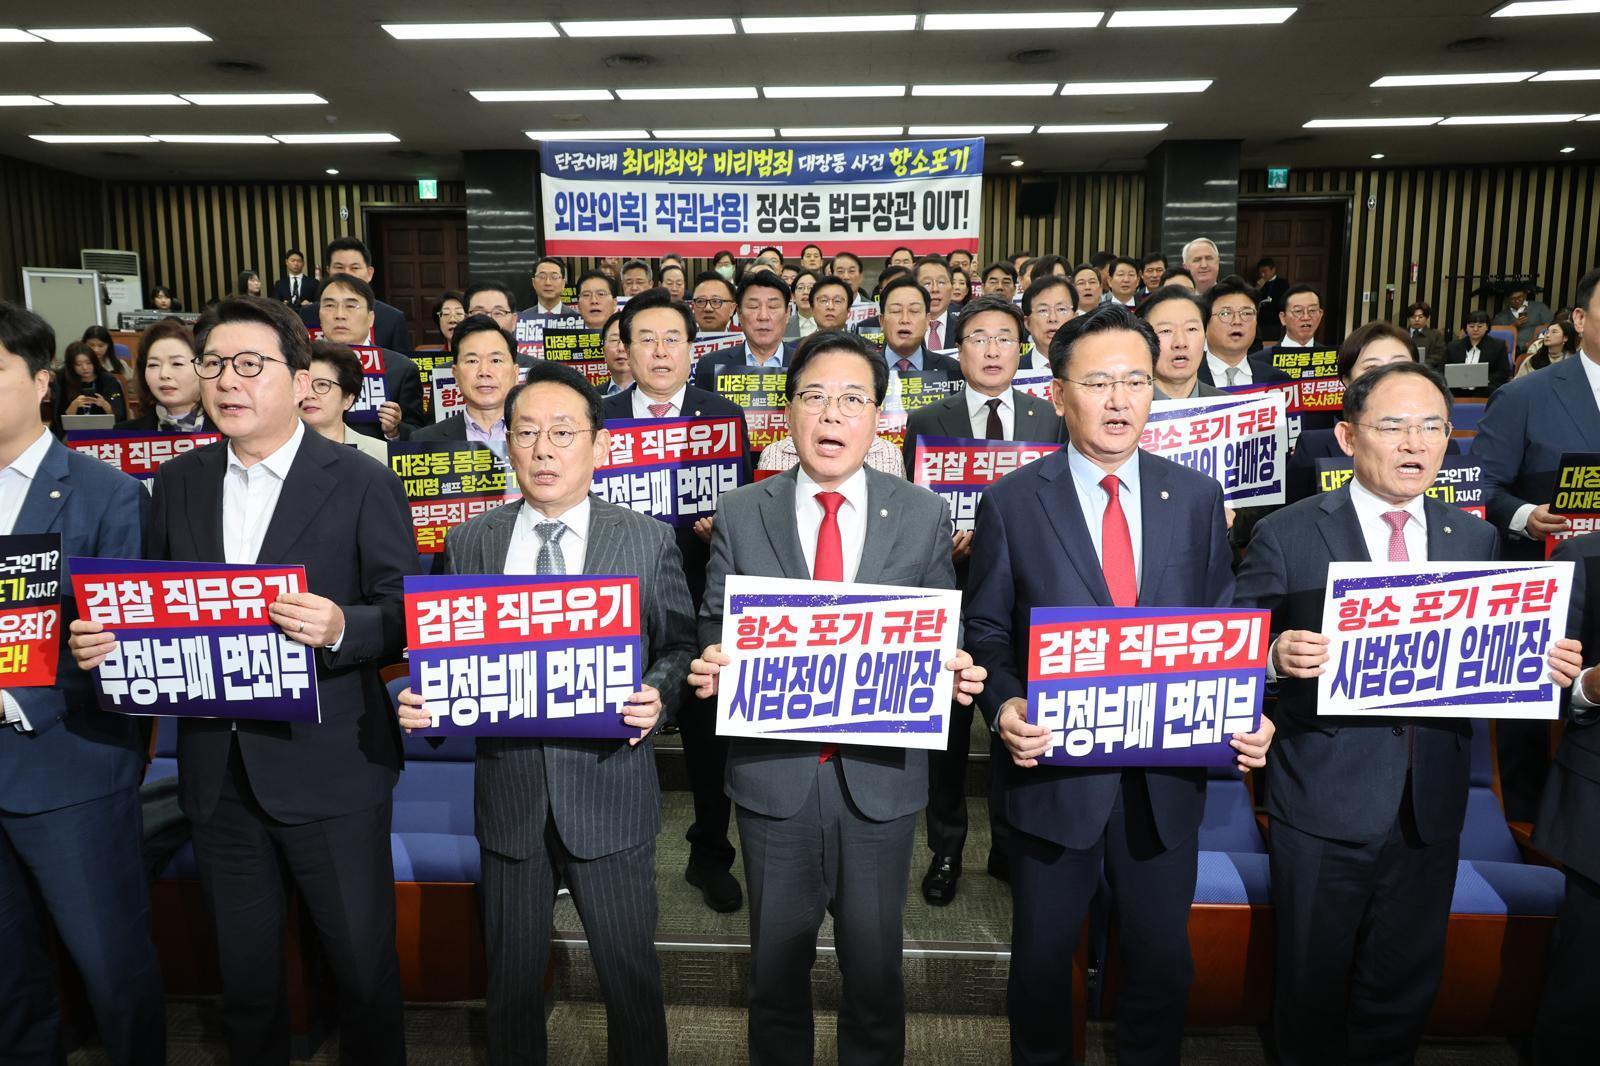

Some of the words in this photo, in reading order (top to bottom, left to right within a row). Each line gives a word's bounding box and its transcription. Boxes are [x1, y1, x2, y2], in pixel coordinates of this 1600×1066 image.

[555, 152, 618, 171] 단군이래
[622, 147, 707, 176] 최대최악
[713, 148, 794, 176] 비리범죄
[798, 153, 847, 173] 대장동
[851, 154, 885, 171] 사건
[889, 146, 970, 176] 항소포기
[554, 192, 647, 233] 외압의혹!
[655, 193, 748, 233] 직권남용!
[757, 192, 821, 233] 정성호
[828, 191, 916, 233] 법무장관
[922, 189, 969, 231] OUT!
[545, 335, 577, 349] 대장동
[578, 334, 601, 348] 몸통
[546, 350, 571, 360] 이재명
[1273, 352, 1310, 367] 대장동
[1311, 350, 1337, 366] 몸통
[717, 374, 760, 392] 대장동
[923, 380, 965, 393] 누구인가?
[641, 421, 736, 460] 직무유기
[1188, 414, 1231, 445] 포기
[1237, 406, 1278, 436] 규탄
[391, 451, 450, 477] 대장동
[452, 449, 492, 473] 몸통
[922, 450, 967, 481] 검찰
[1223, 433, 1277, 490] 암매장
[1434, 466, 1481, 483] 구인가?
[1456, 489, 1482, 501] 지시?
[0, 550, 59, 574] 구인가?
[26, 581, 58, 599] 지시?
[84, 580, 154, 624] 검찰
[1337, 595, 1401, 632] 항소
[1410, 586, 1480, 624] 포기
[1487, 578, 1558, 617] 규탄
[416, 595, 487, 645] 검찰
[497, 583, 632, 637] 직무유기
[736, 615, 798, 651] 항소
[806, 611, 873, 647] 포기
[881, 608, 947, 645] 규탄
[1039, 627, 1110, 676] 검찰
[1118, 617, 1262, 668] 직무유기
[1329, 628, 1452, 700] 사법정의
[1456, 617, 1551, 690] 암매장
[98, 635, 216, 706] 부정부패
[218, 632, 309, 701] 면죄부
[420, 650, 538, 728] 부정부패
[546, 644, 635, 719] 면죄부
[728, 653, 848, 722] 사법정의
[851, 648, 941, 717] 암매장
[1036, 682, 1157, 758] 부정부패
[1161, 676, 1256, 750] 면죄부
